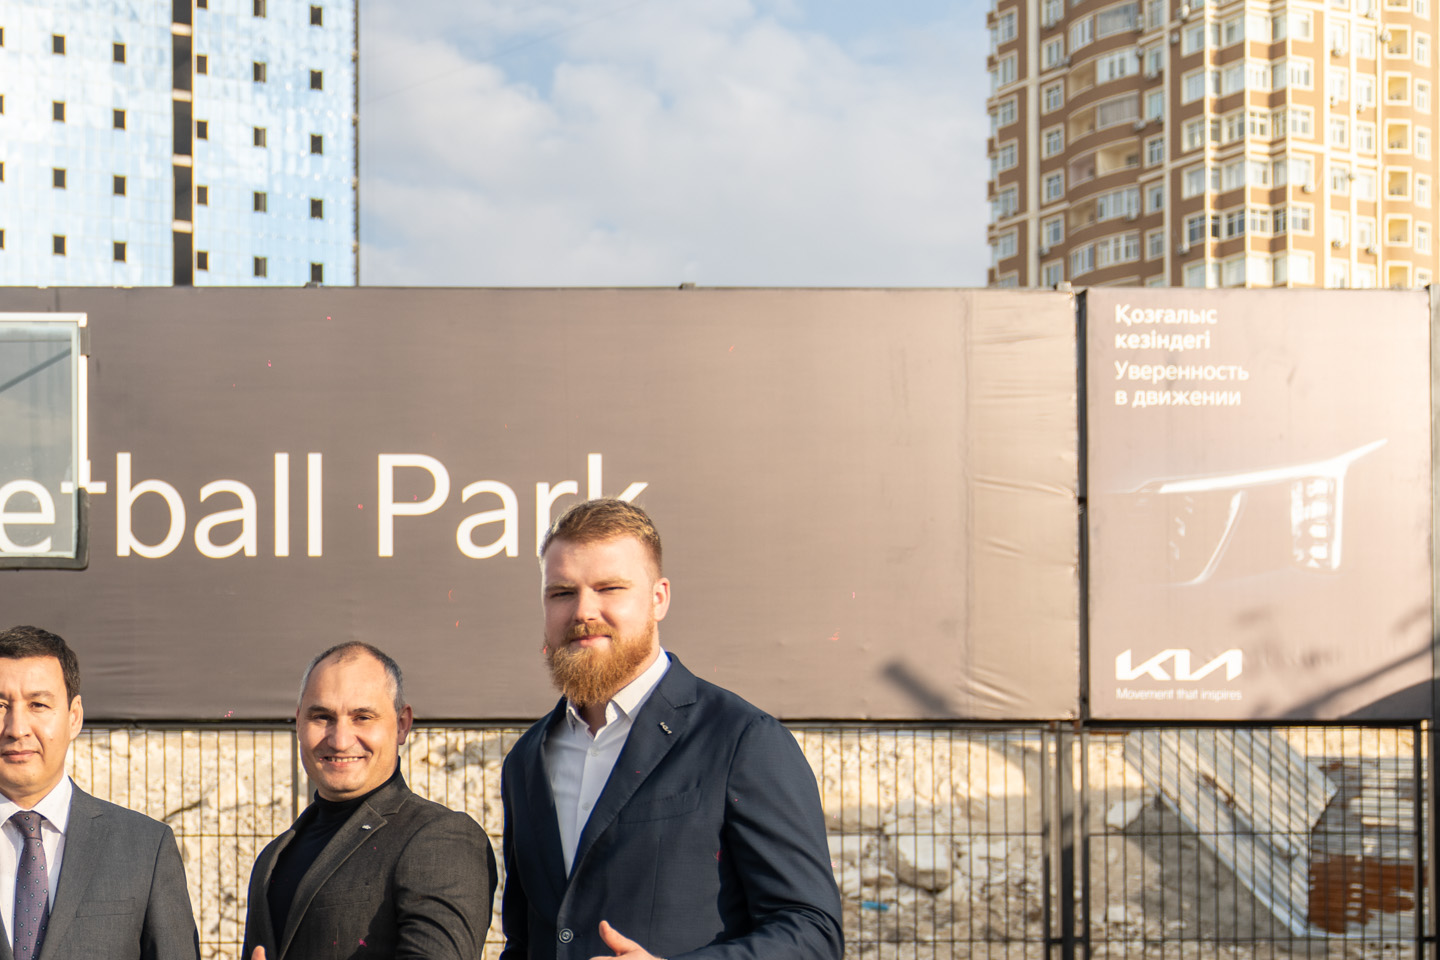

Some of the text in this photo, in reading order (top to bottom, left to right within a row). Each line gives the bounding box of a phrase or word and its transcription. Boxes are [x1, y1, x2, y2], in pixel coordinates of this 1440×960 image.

[1115, 303, 1218, 327] Қозғалыс
[1115, 329, 1211, 352] кезіндегі
[1114, 360, 1250, 385] Уверенность
[1115, 390, 1242, 409] в движении
[1116, 687, 1243, 702] Movement that inspires
